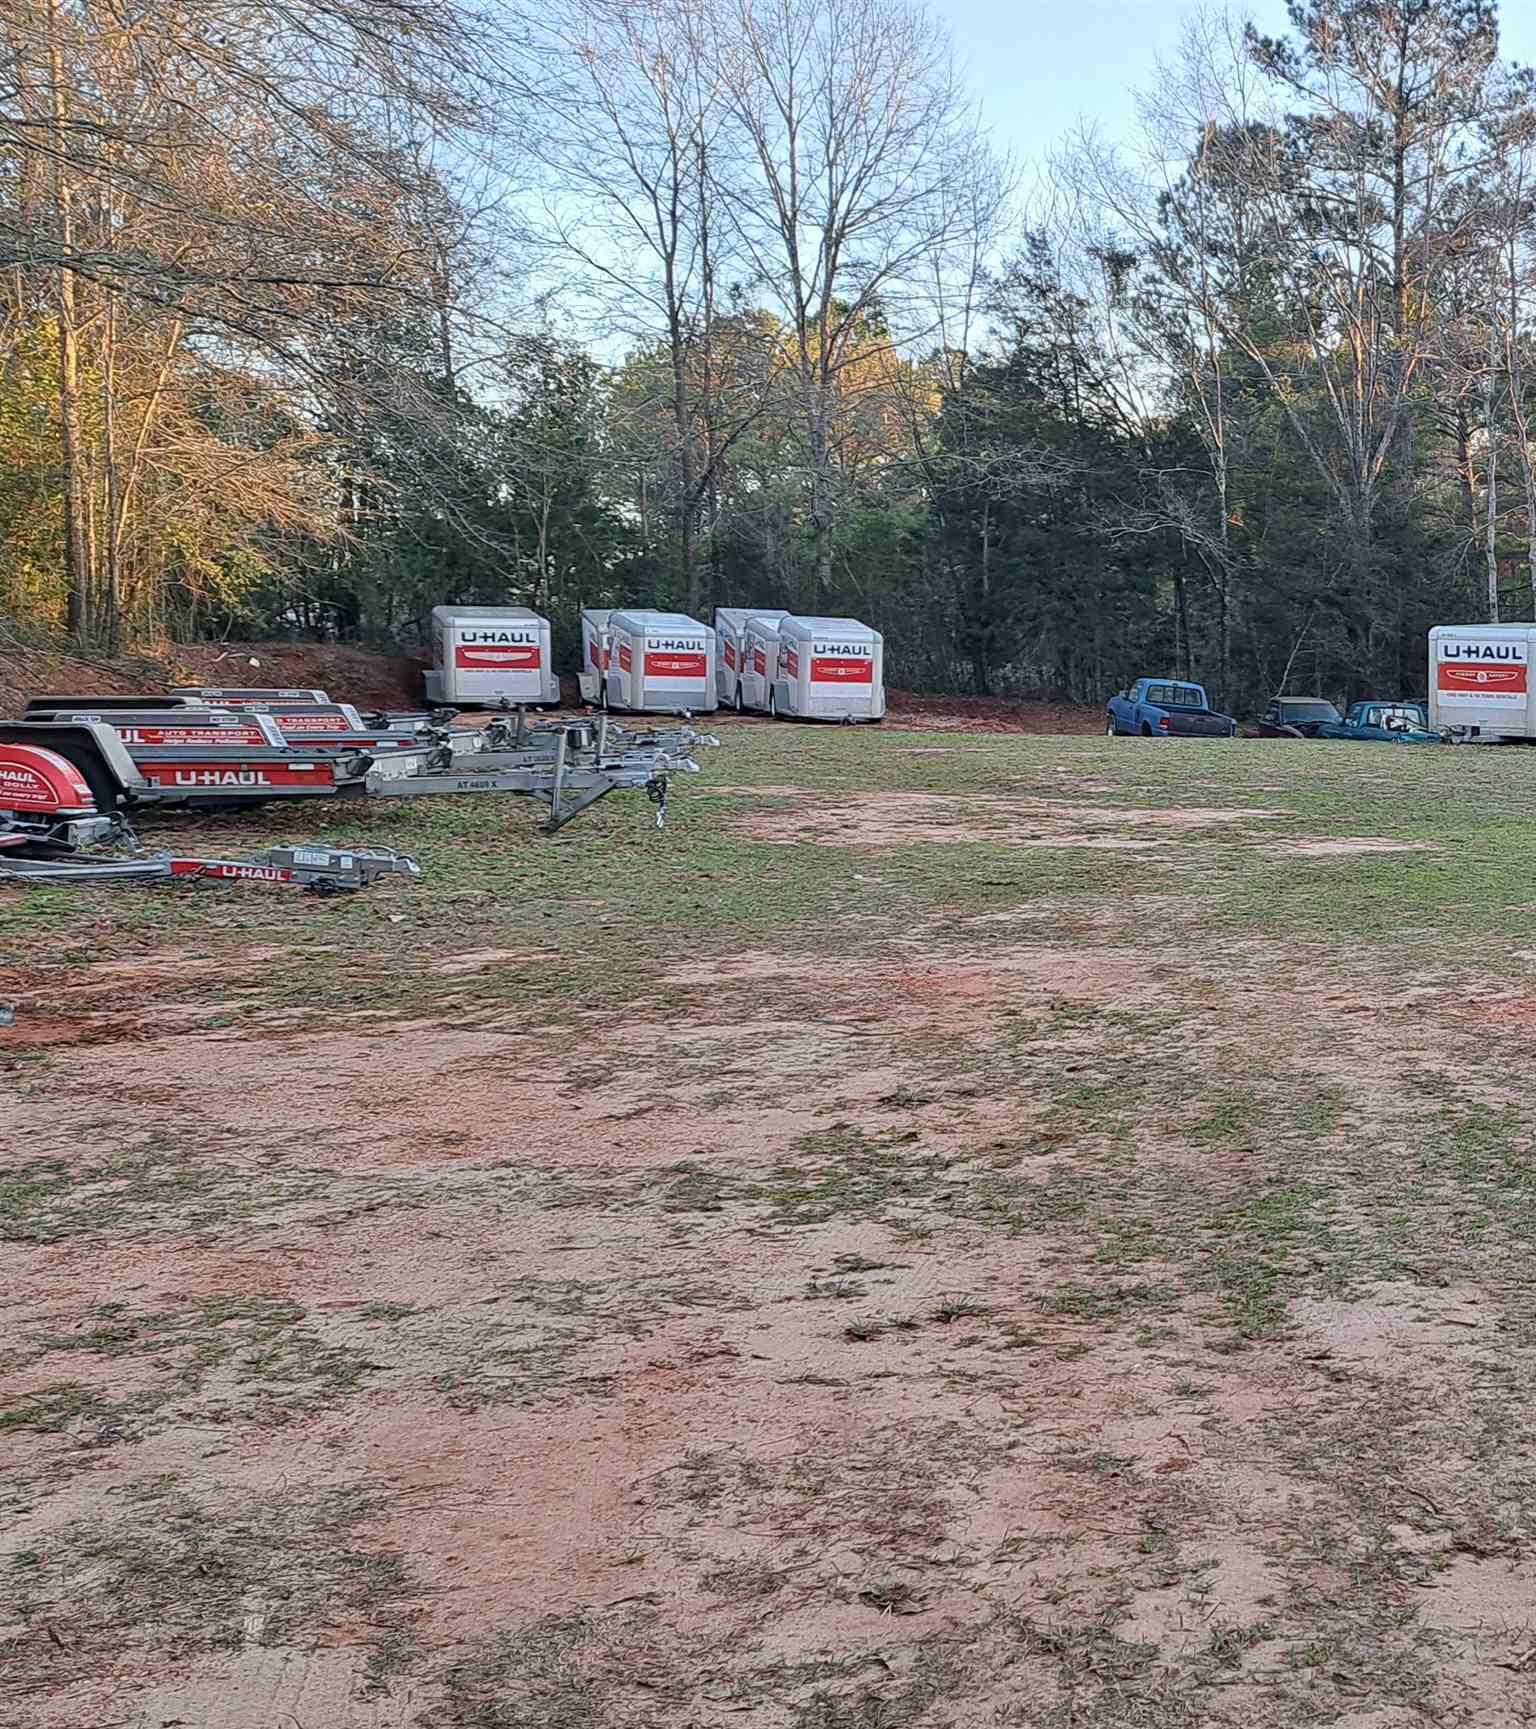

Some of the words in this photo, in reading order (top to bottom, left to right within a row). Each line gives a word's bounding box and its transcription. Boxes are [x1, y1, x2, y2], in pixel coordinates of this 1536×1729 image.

[461, 632, 537, 643] U-HAUL
[648, 640, 705, 651] U-HAUL
[813, 644, 871, 656] U-HAUL
[1444, 645, 1523, 660] U-HAUL
[0, 770, 36, 783] HAUL
[175, 770, 271, 785] U-HAUL
[222, 866, 287, 881] U-HAUL
